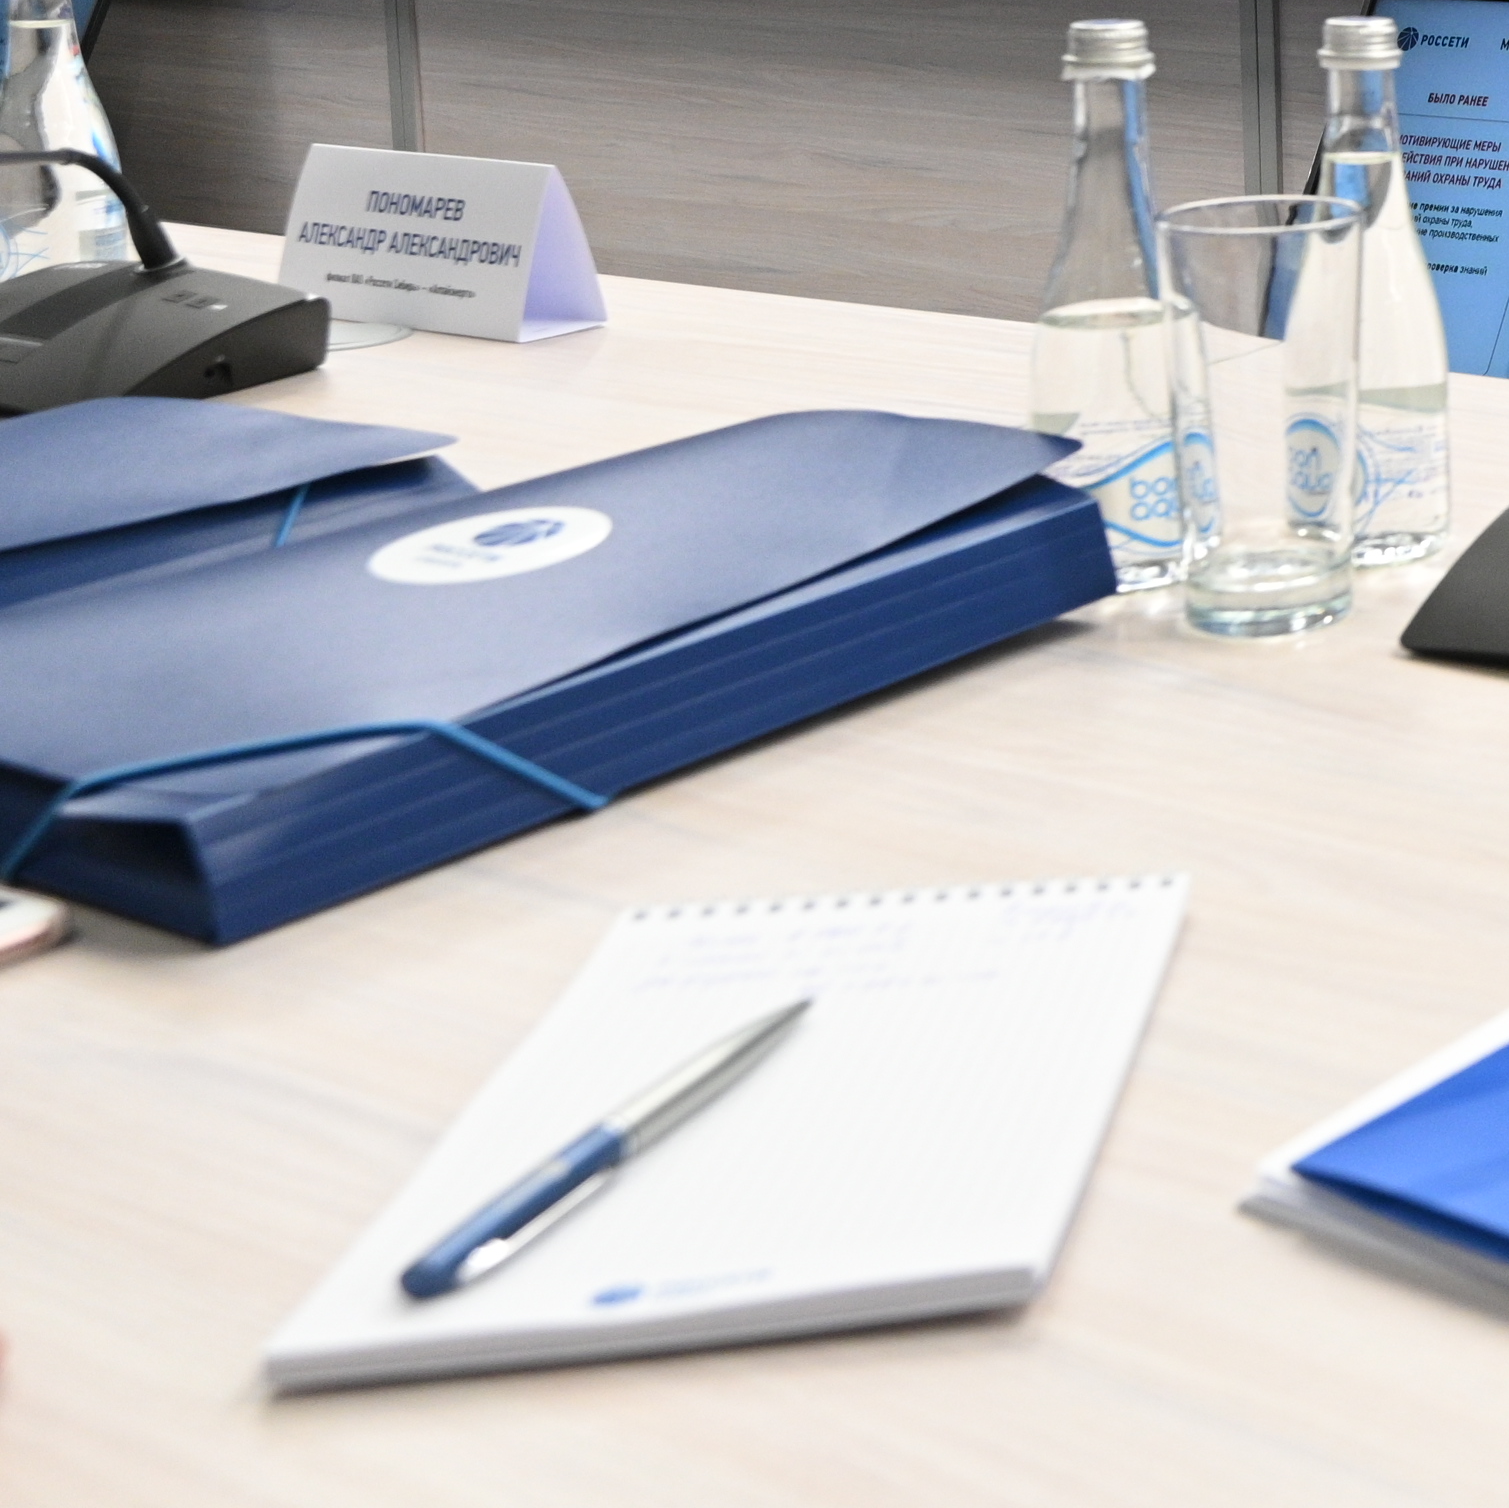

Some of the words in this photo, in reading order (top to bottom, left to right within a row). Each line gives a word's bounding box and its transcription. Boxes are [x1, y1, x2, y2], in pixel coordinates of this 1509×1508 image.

[1420, 34, 1470, 48] РОССЕТИ
[1427, 92, 1456, 105] БЫЛО
[1457, 94, 1489, 107] РАНЕЕ
[1473, 140, 1502, 153] МЕРЫ
[1402, 151, 1443, 165] ЕЙСТВИЯ
[1444, 154, 1465, 168] ПРИ
[1432, 172, 1471, 187] ОХРАНЫ
[1472, 176, 1502, 190] ТРУДА
[365, 189, 466, 222] ПОНОМАРЕВ
[1420, 203, 1450, 213] премии
[1450, 206, 1460, 214] за
[1460, 207, 1503, 218] нарушения
[1422, 216, 1450, 226] охраны
[1429, 228, 1500, 243] производственных
[297, 220, 387, 256] АЛЕКСАНДР
[388, 232, 522, 268] АЛЕКСАНДРОВИЧ
[1460, 266, 1488, 276] знаний
